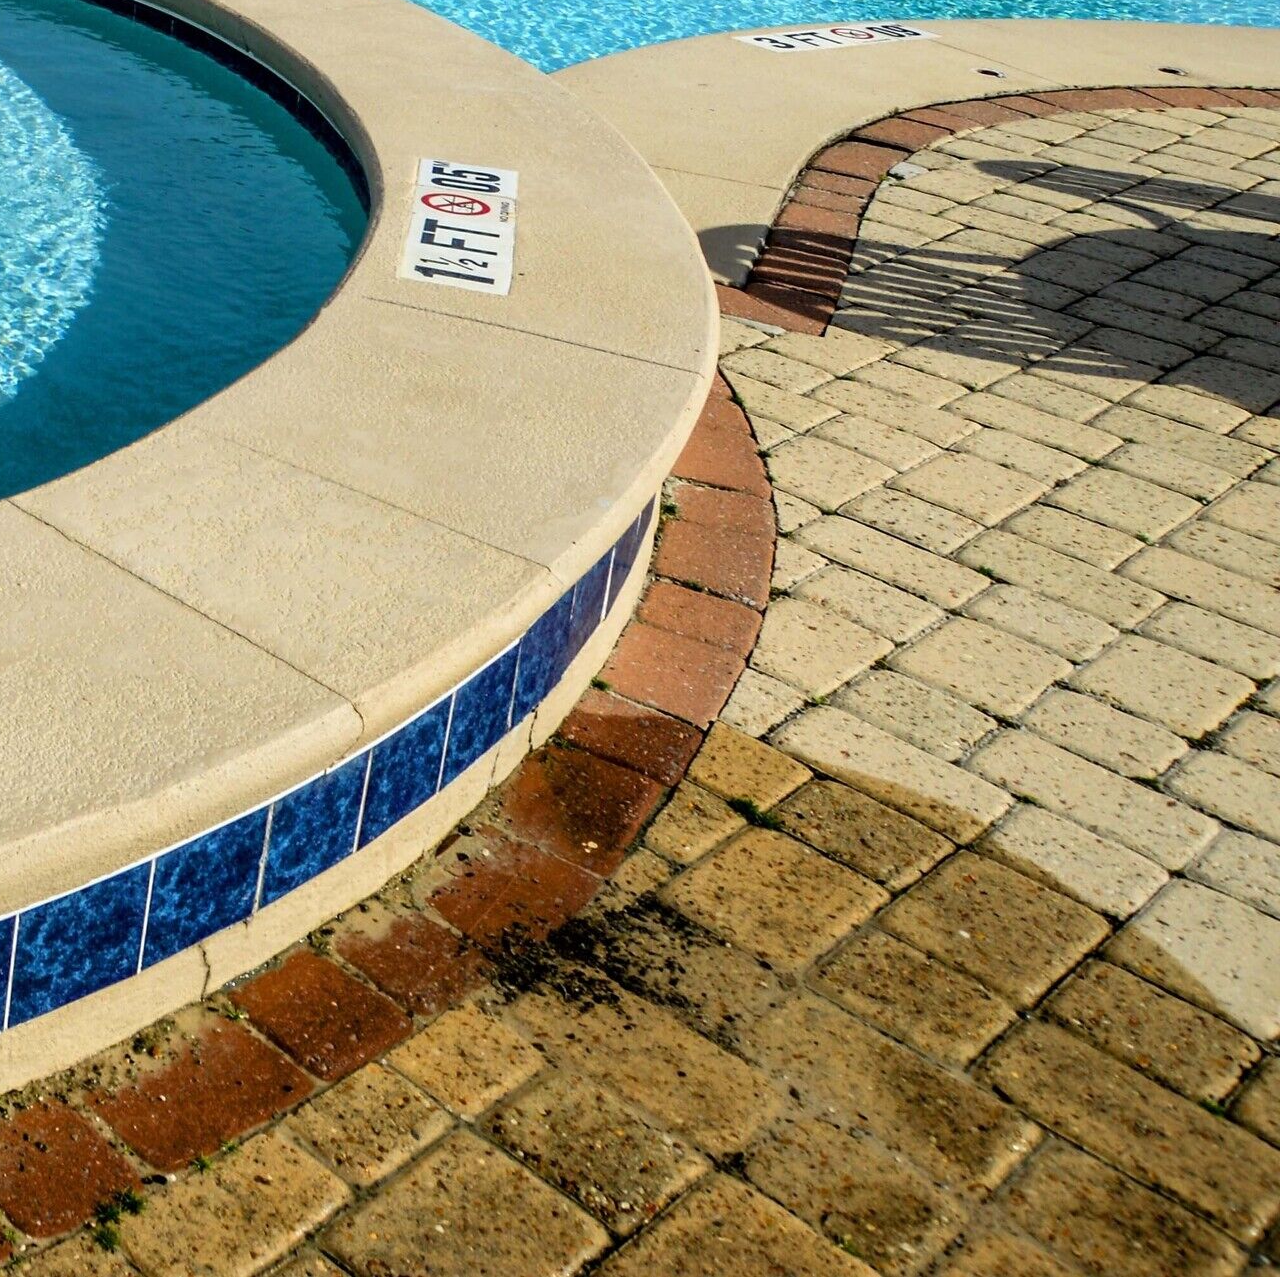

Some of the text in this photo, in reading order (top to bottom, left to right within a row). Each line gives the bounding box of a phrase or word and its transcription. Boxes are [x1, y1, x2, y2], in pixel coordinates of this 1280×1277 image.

[753, 36, 796, 49] 3
[784, 31, 843, 47] FT
[420, 218, 500, 256] FT
